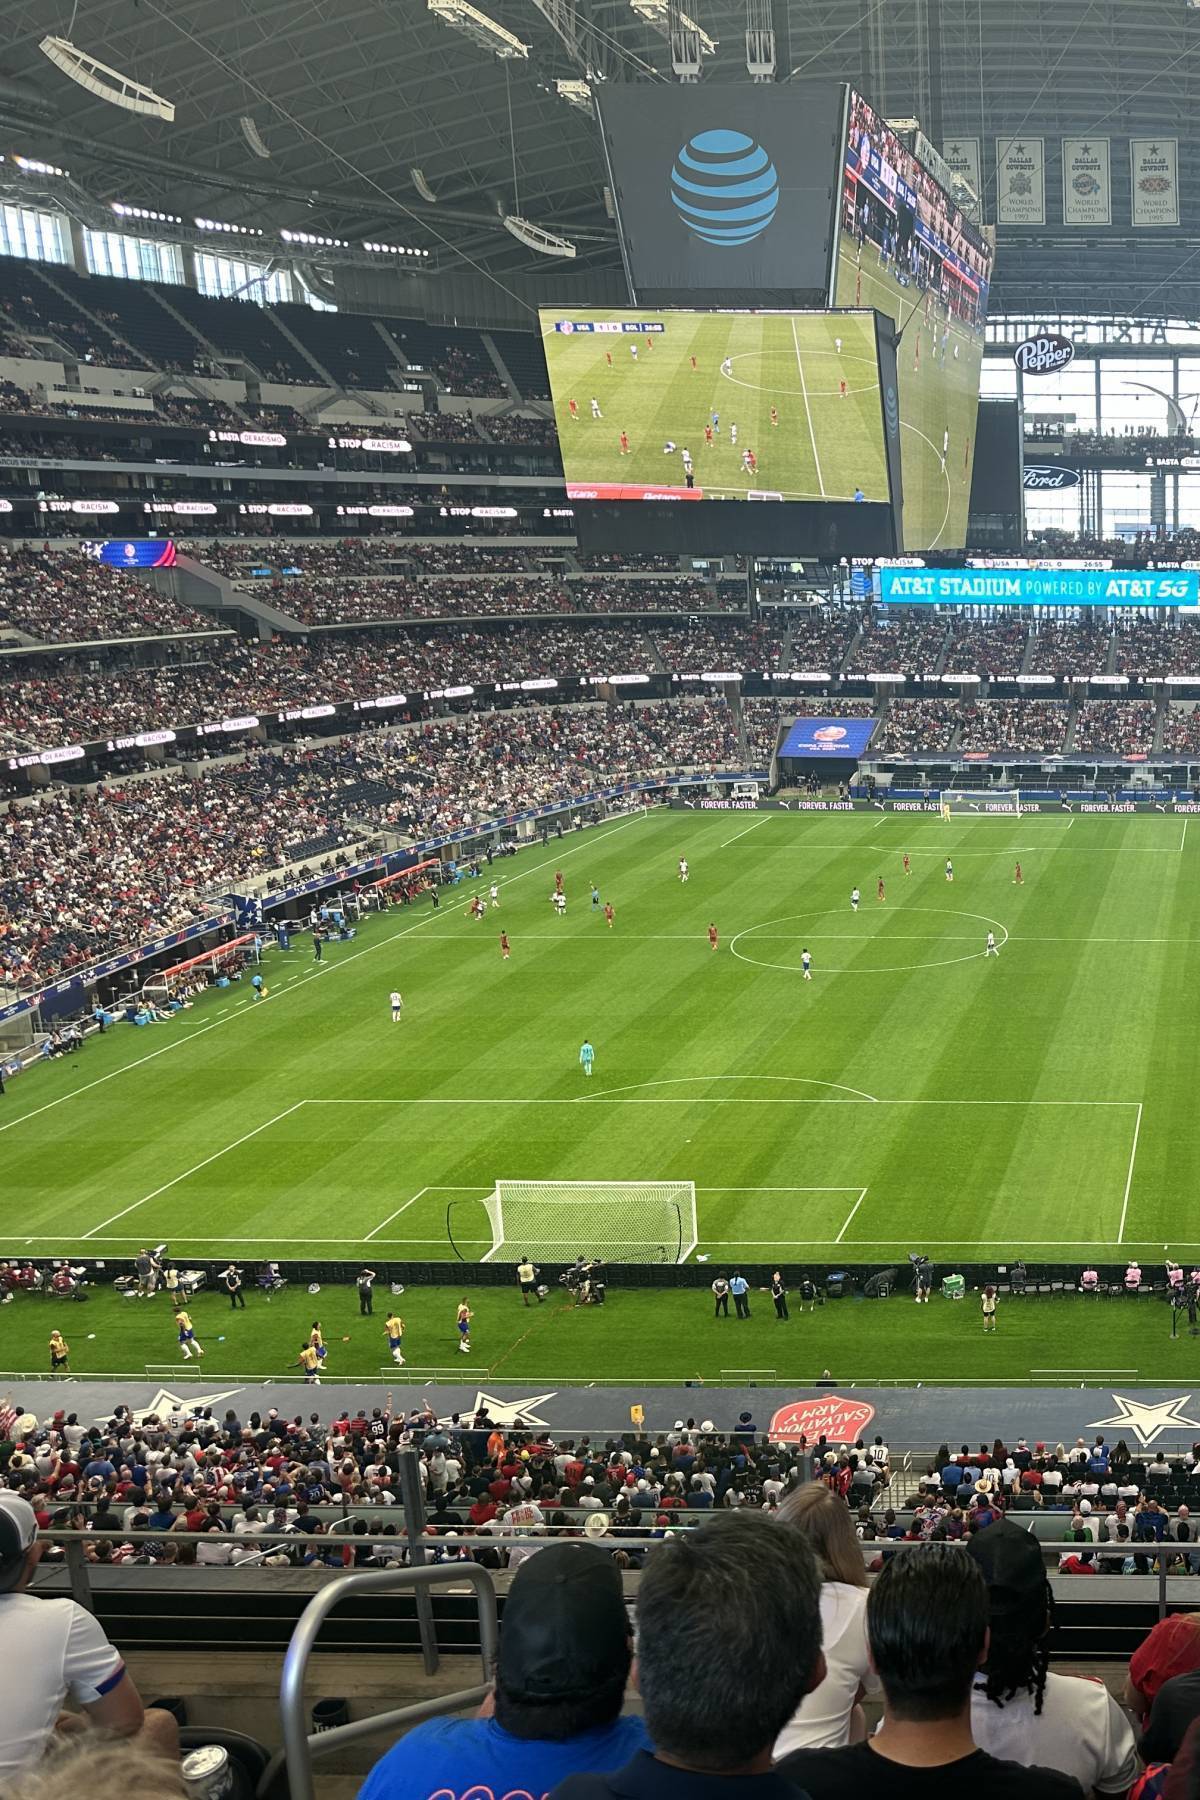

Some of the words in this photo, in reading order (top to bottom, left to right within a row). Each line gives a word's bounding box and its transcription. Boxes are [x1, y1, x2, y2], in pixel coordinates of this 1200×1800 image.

[1036, 339, 1058, 355] Dr
[339, 439, 361, 448] STOP
[372, 440, 400, 449] RACISM
[1024, 468, 1064, 486] Ford
[50, 502, 71, 511] STOP
[248, 505, 268, 513] STOP
[890, 577, 935, 595] AT&T
[939, 577, 1021, 596] STADIUM
[1026, 580, 1083, 595] POWERED
[1088, 581, 1102, 595] BY
[1106, 579, 1156, 598] AT&T
[1156, 580, 1190, 597] 5G
[286, 710, 301, 720] STOP
[116, 737, 135, 749] STOP
[143, 733, 167, 742] RACISM
[17, 756, 40, 766] BASTA
[732, 801, 758, 809] FASTER.
[798, 801, 829, 810] FOREVER.
[830, 802, 855, 810] FASTER.
[893, 803, 923, 811] FOREVER.
[985, 804, 1016, 812] FOREVER.
[1111, 805, 1137, 813] FASTER.
[784, 1402, 843, 1424] ARMY
[778, 1408, 870, 1433] SALVATION
[372, 1424, 384, 1435] 99
[806, 1425, 846, 1441] THE
[874, 1450, 883, 1459] 10
